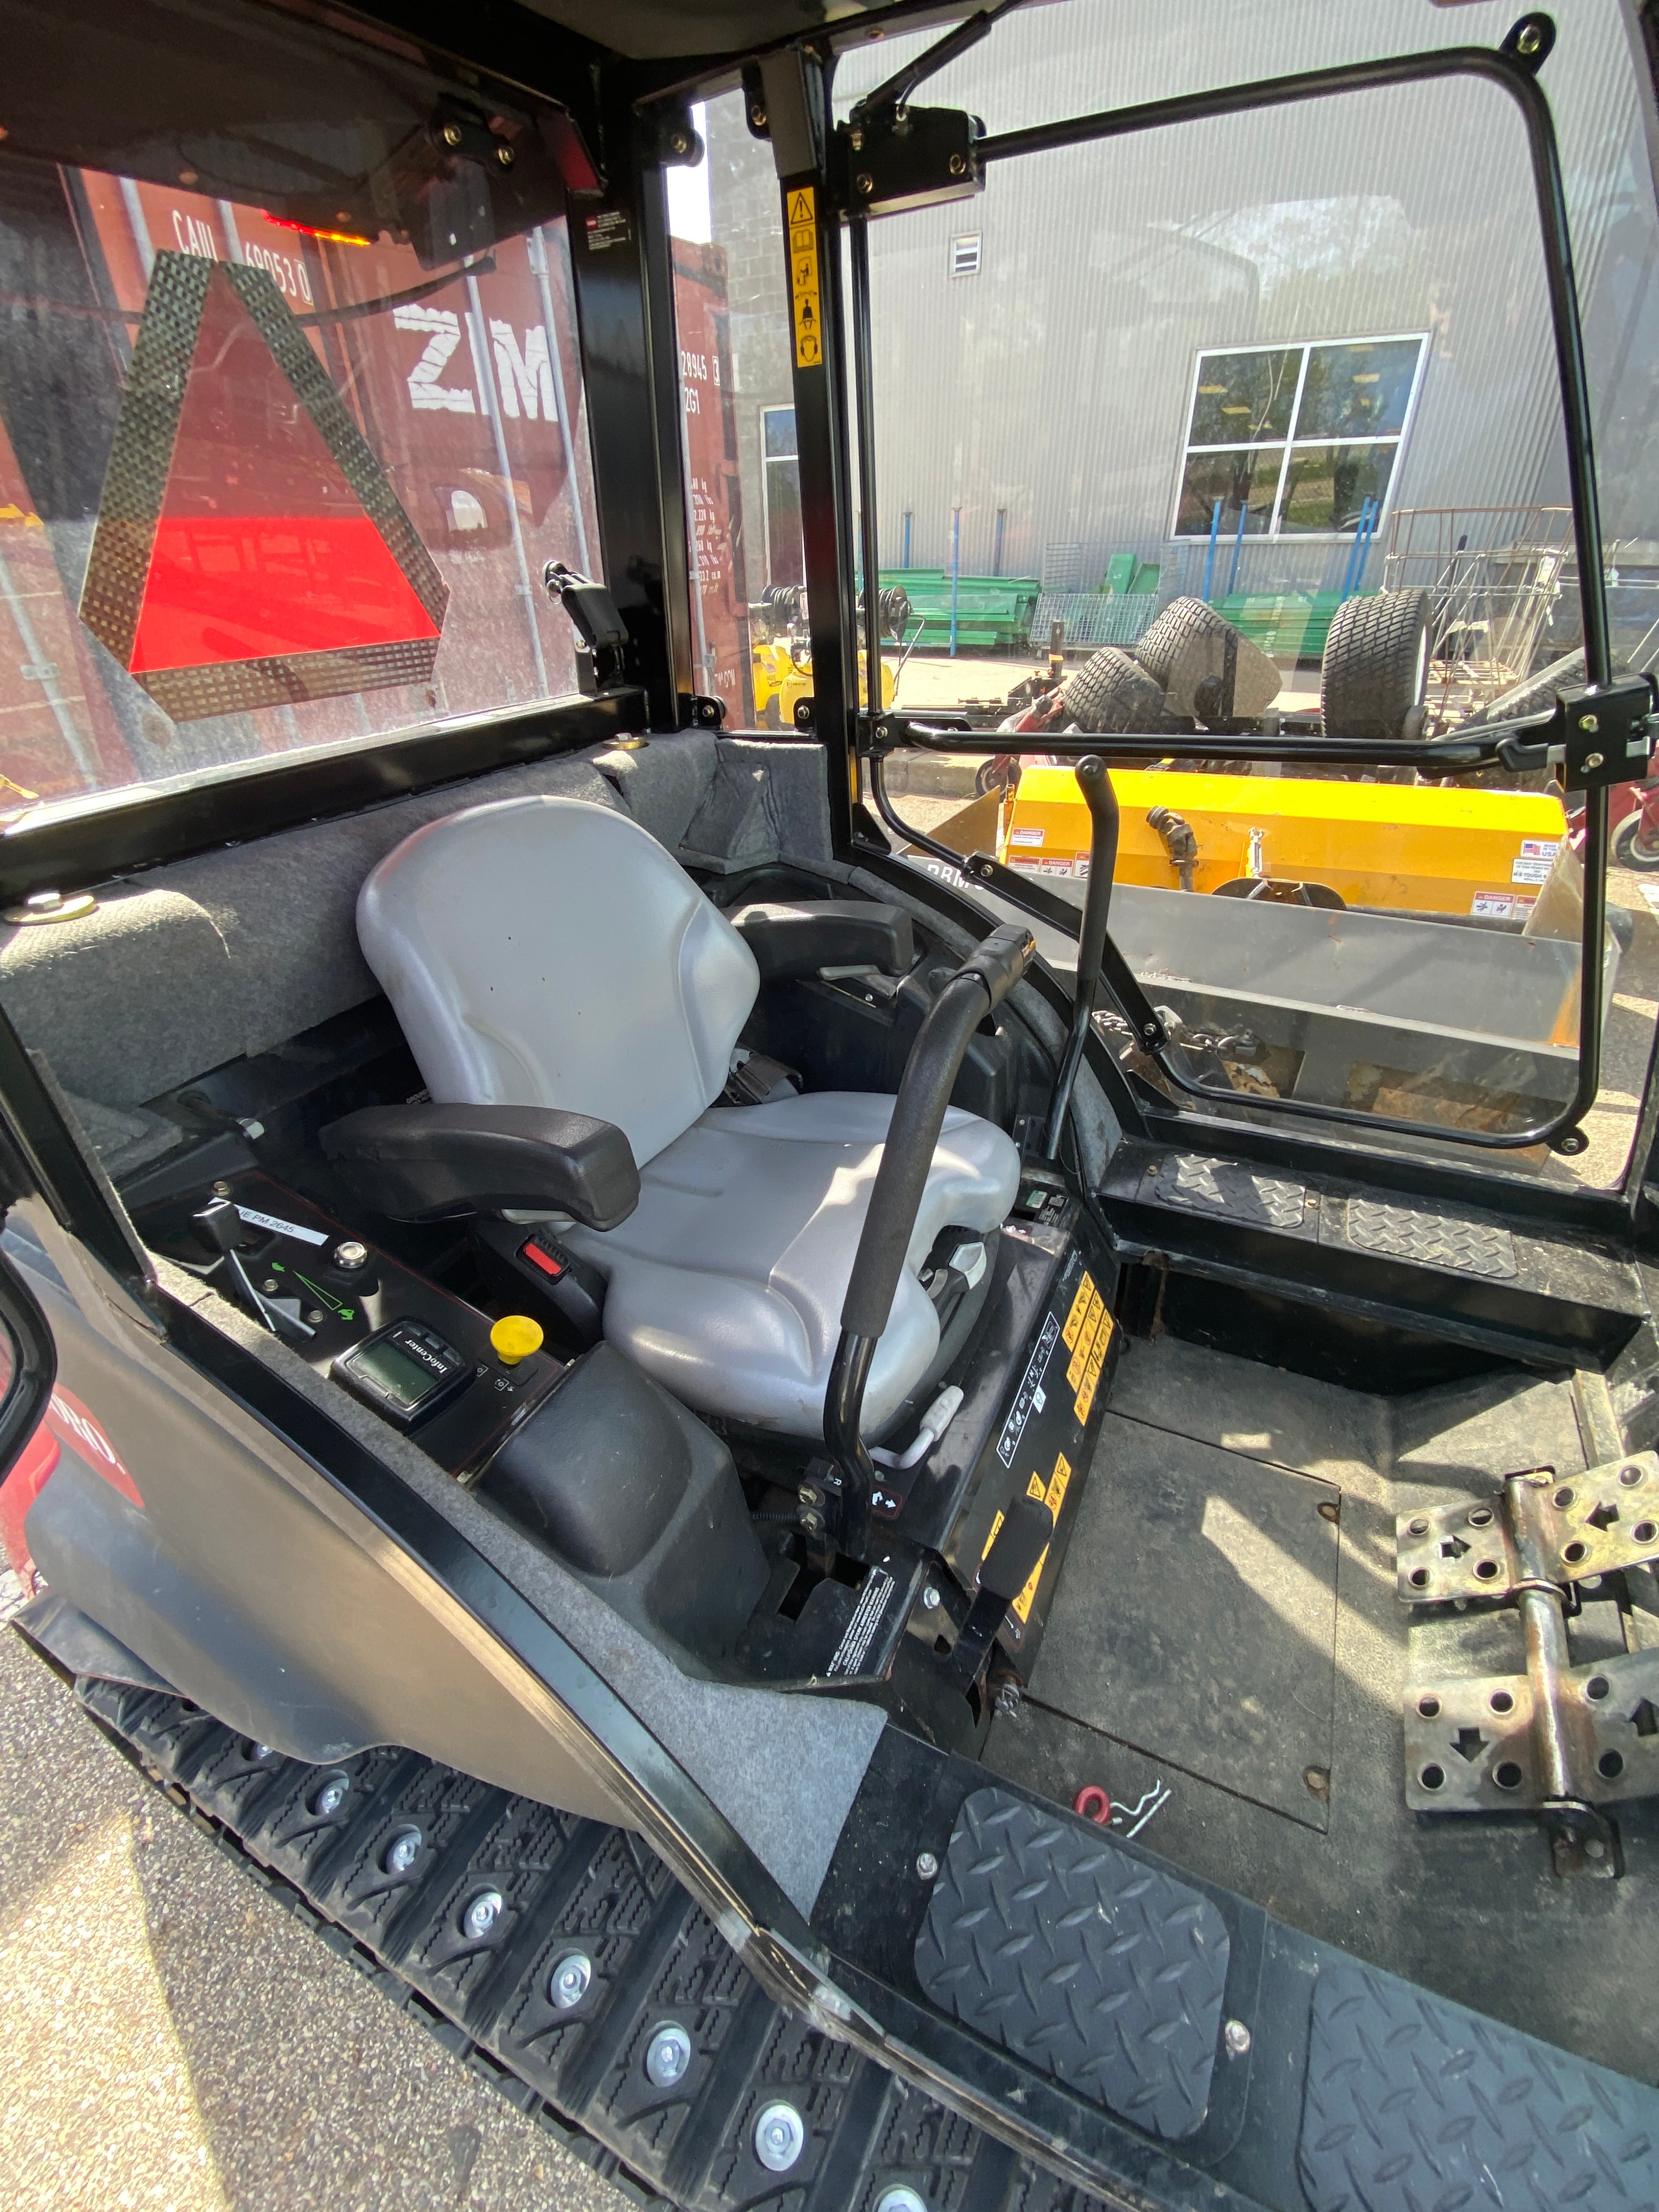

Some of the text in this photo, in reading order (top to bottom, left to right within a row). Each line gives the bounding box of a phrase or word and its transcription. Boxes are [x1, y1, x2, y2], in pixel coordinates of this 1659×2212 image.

[393, 303, 558, 421] ZIM
[252, 1215, 269, 1224] PM
[269, 1221, 295, 1233] 2645
[404, 1340, 448, 1374] InfoCenter
